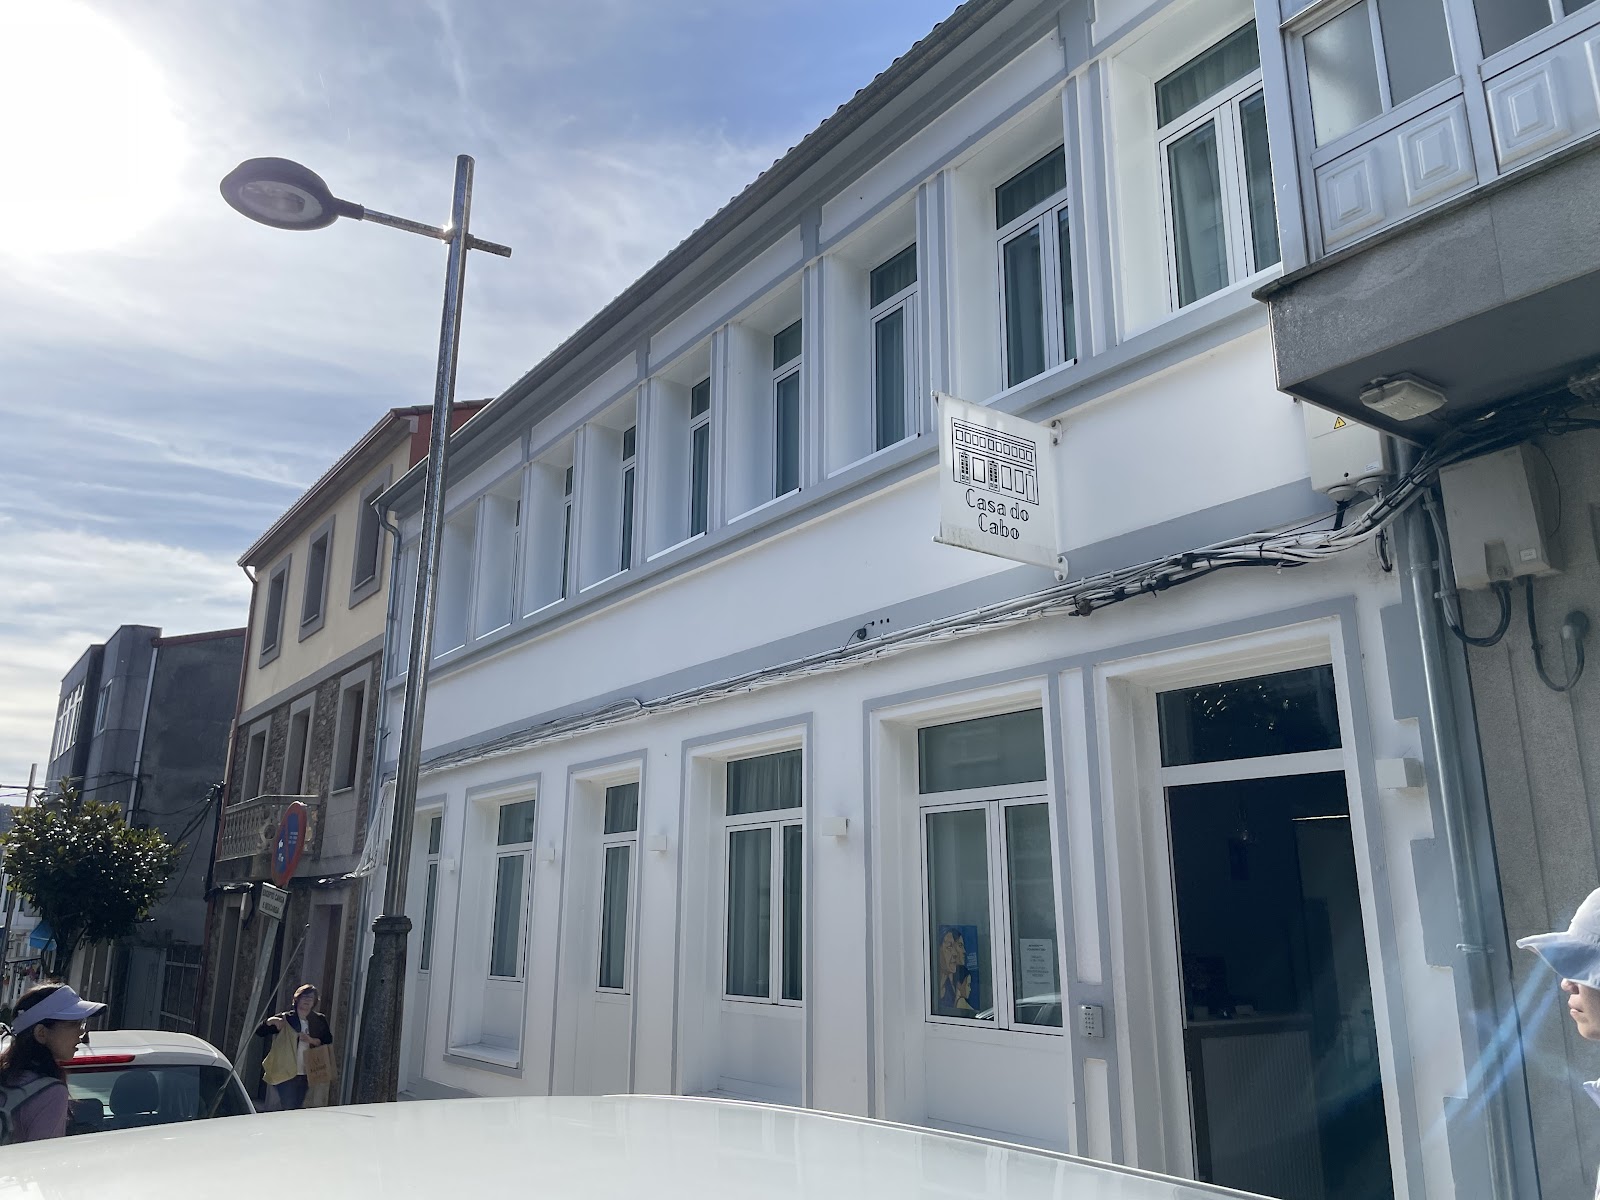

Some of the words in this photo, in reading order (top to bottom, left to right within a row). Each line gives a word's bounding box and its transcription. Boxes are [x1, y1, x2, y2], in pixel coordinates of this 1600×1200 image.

[965, 488, 1006, 517] Casa
[1010, 502, 1030, 521] do
[978, 512, 1020, 540] Cabo
